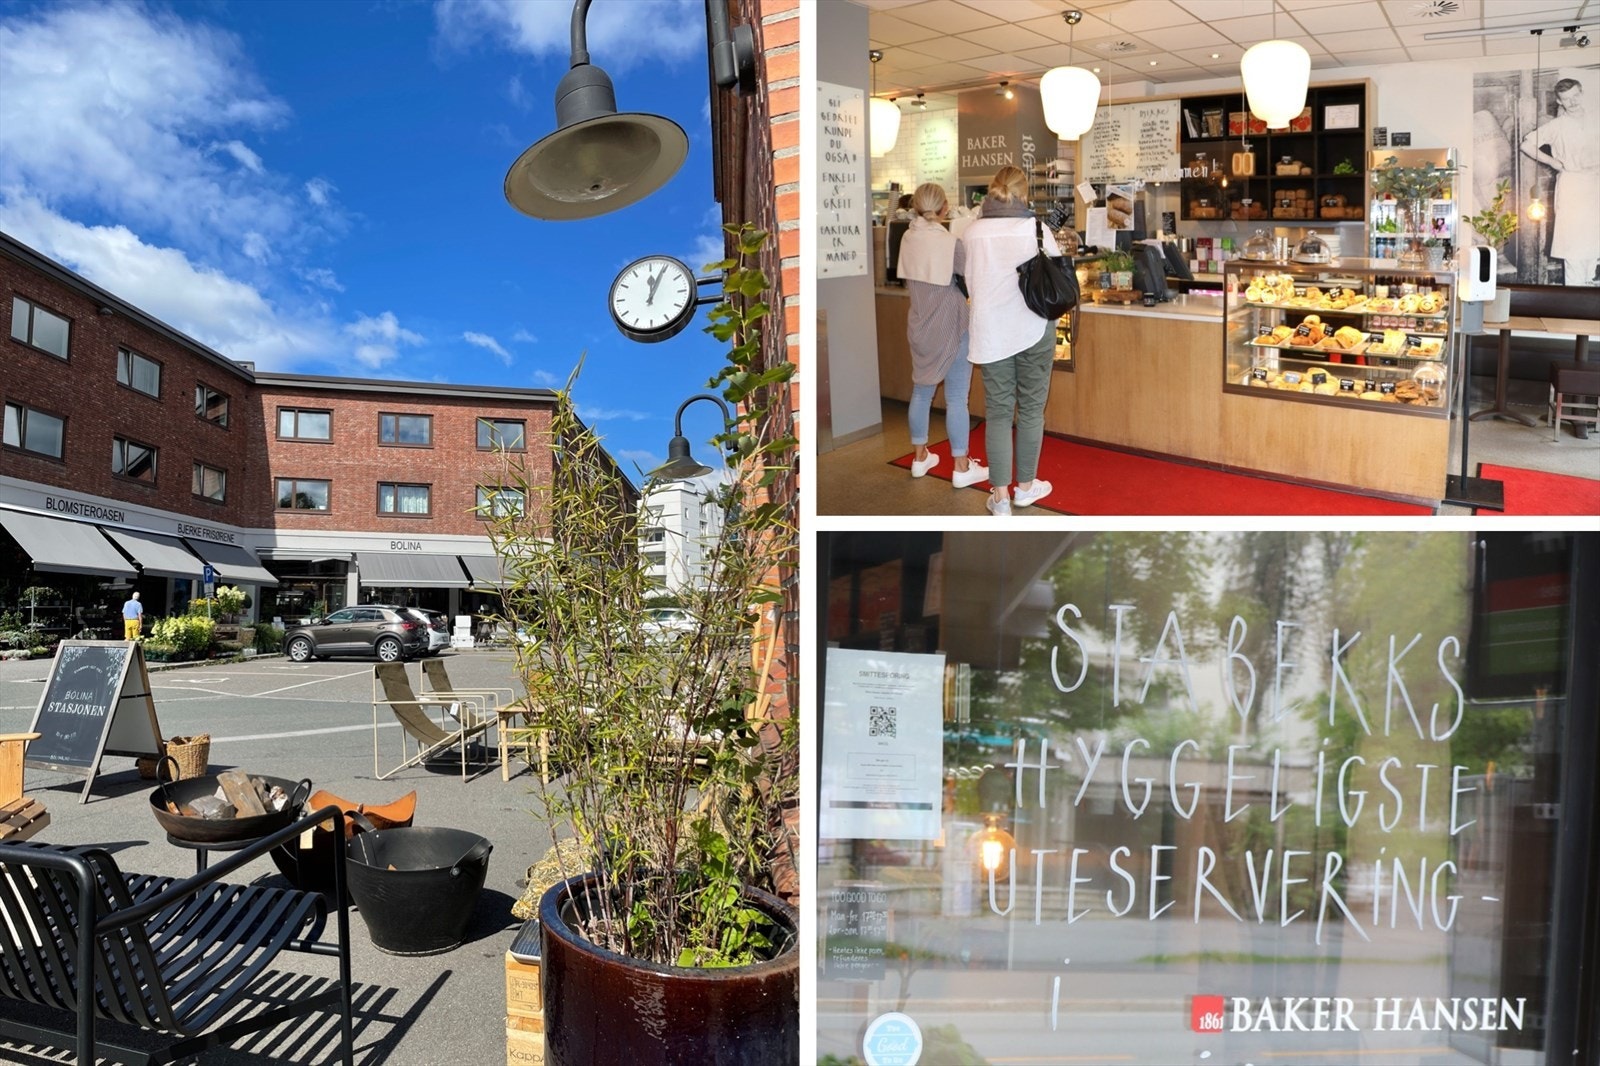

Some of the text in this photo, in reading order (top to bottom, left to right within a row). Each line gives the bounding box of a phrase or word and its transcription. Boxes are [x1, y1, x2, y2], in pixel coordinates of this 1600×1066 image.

[830, 139, 842, 149] DU
[967, 135, 1007, 150] BAKER
[962, 152, 1013, 168] HANSEN
[824, 198, 852, 210] GREIT
[46, 497, 125, 523] BLOMSTEROASEN
[177, 523, 235, 543] BJERKE FRISØRENE
[390, 540, 422, 551] BOLINA
[206, 567, 212, 582] P
[1051, 603, 1464, 742] STABEKKS
[64, 691, 93, 701] BOLINA
[47, 702, 107, 717] STASJONEN
[1004, 738, 1477, 835] HYGGELIGSTE
[1199, 996, 1527, 1032] 1861 BAKER HANSEN
